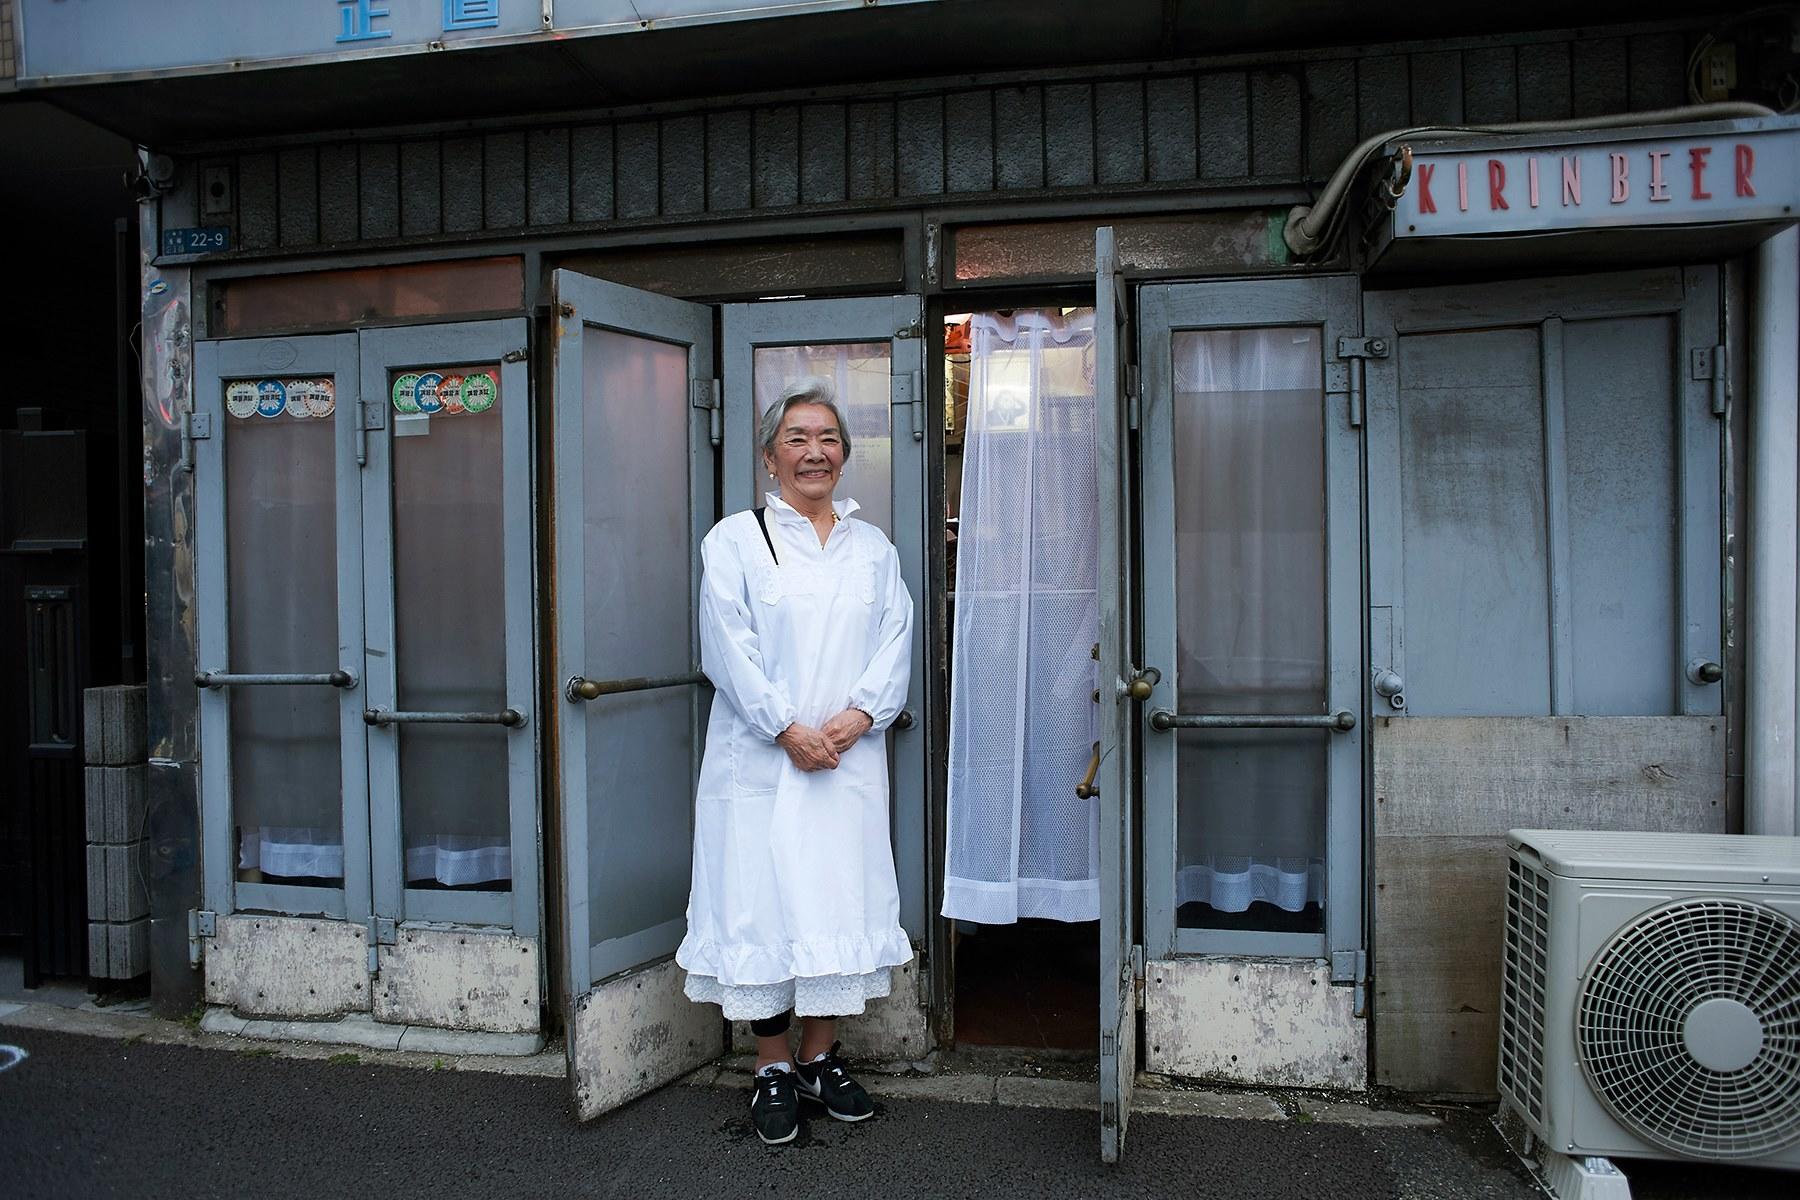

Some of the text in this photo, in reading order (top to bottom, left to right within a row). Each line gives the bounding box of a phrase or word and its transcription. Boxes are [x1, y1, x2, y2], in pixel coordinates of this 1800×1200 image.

[1418, 143, 1756, 214] KIRIN BEER
[191, 232, 224, 247] 22-9
